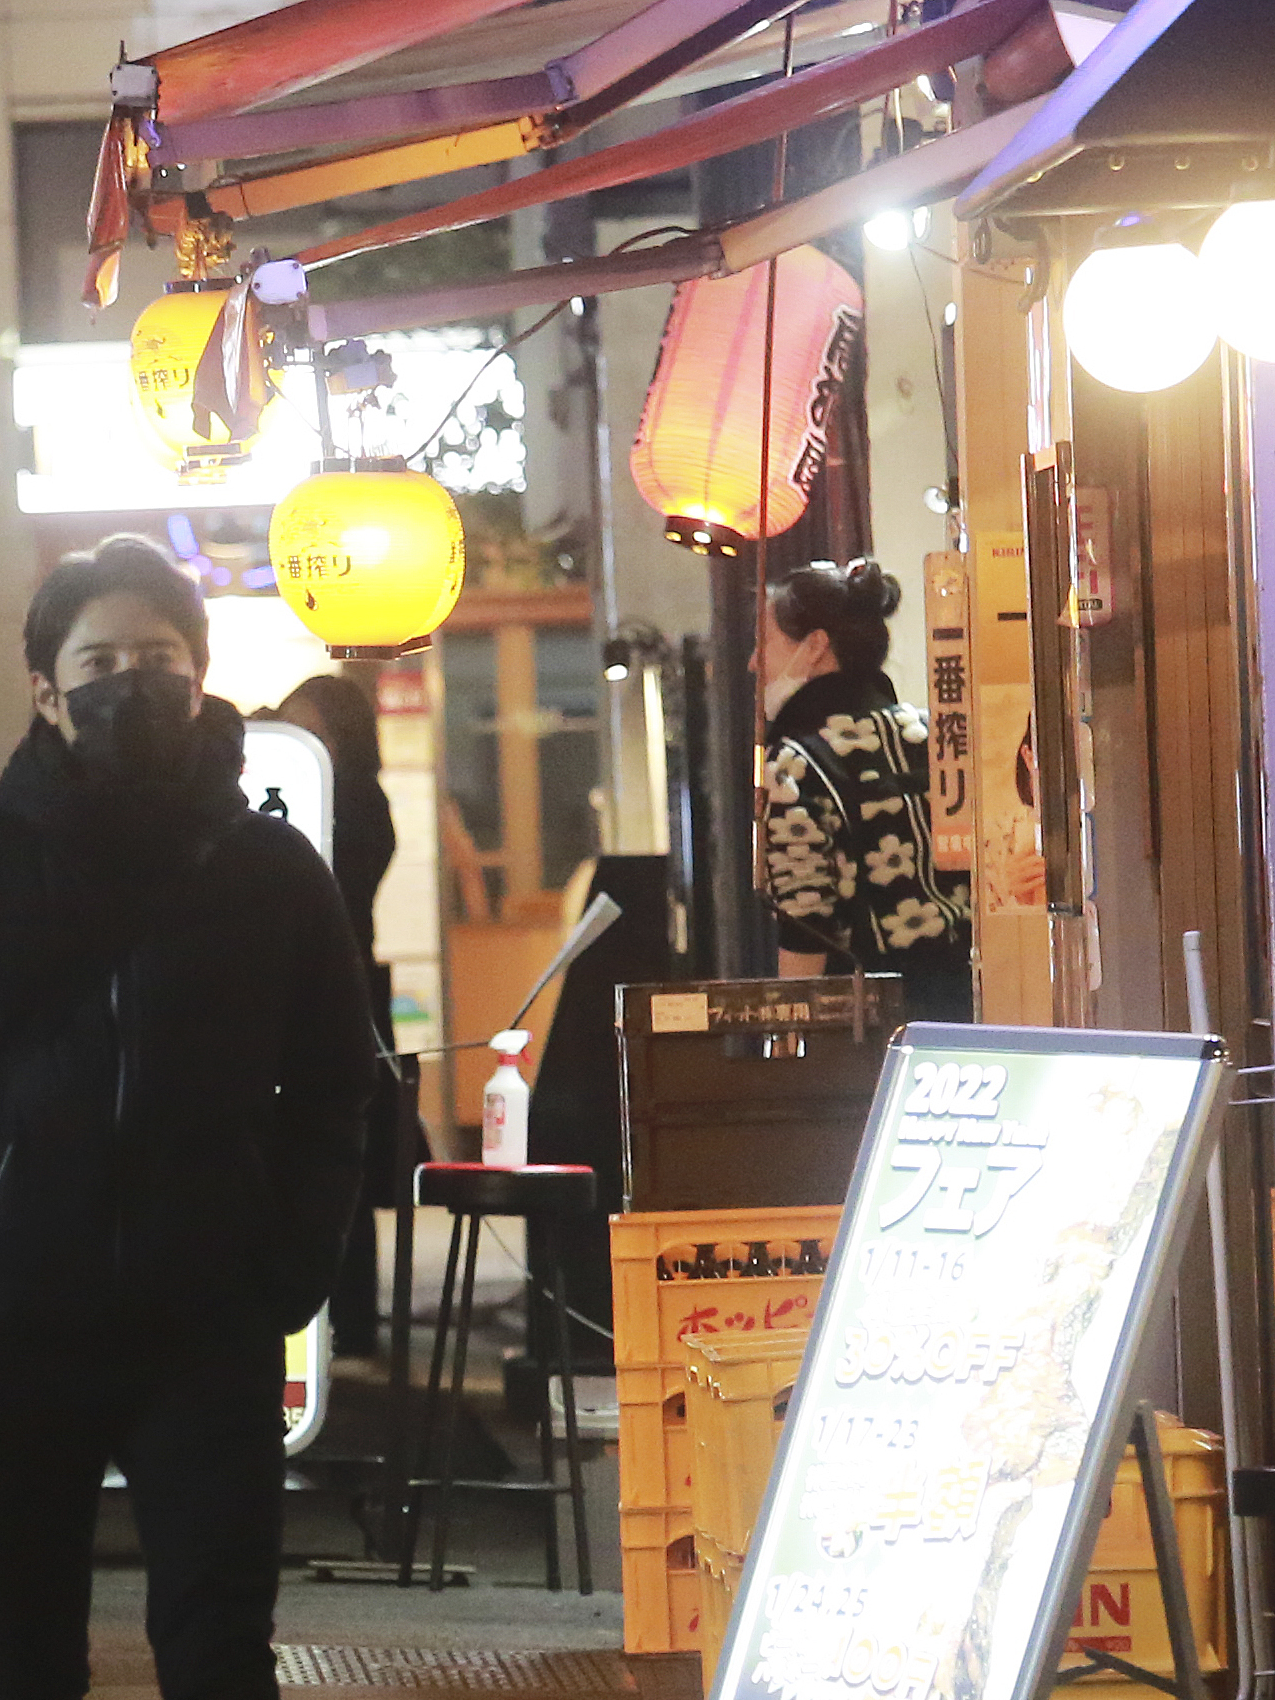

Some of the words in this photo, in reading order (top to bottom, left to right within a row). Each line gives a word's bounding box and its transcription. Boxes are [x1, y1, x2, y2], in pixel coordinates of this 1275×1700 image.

[932, 626, 970, 817] 一番搾り
[903, 1062, 1008, 1118] 2022
[878, 1145, 1044, 1239] フェア
[864, 1243, 967, 1287] 1/11-16
[677, 1294, 816, 1342] ホッピ
[835, 1325, 1026, 1389] 30%OFF
[818, 1412, 920, 1454] 1/17-23
